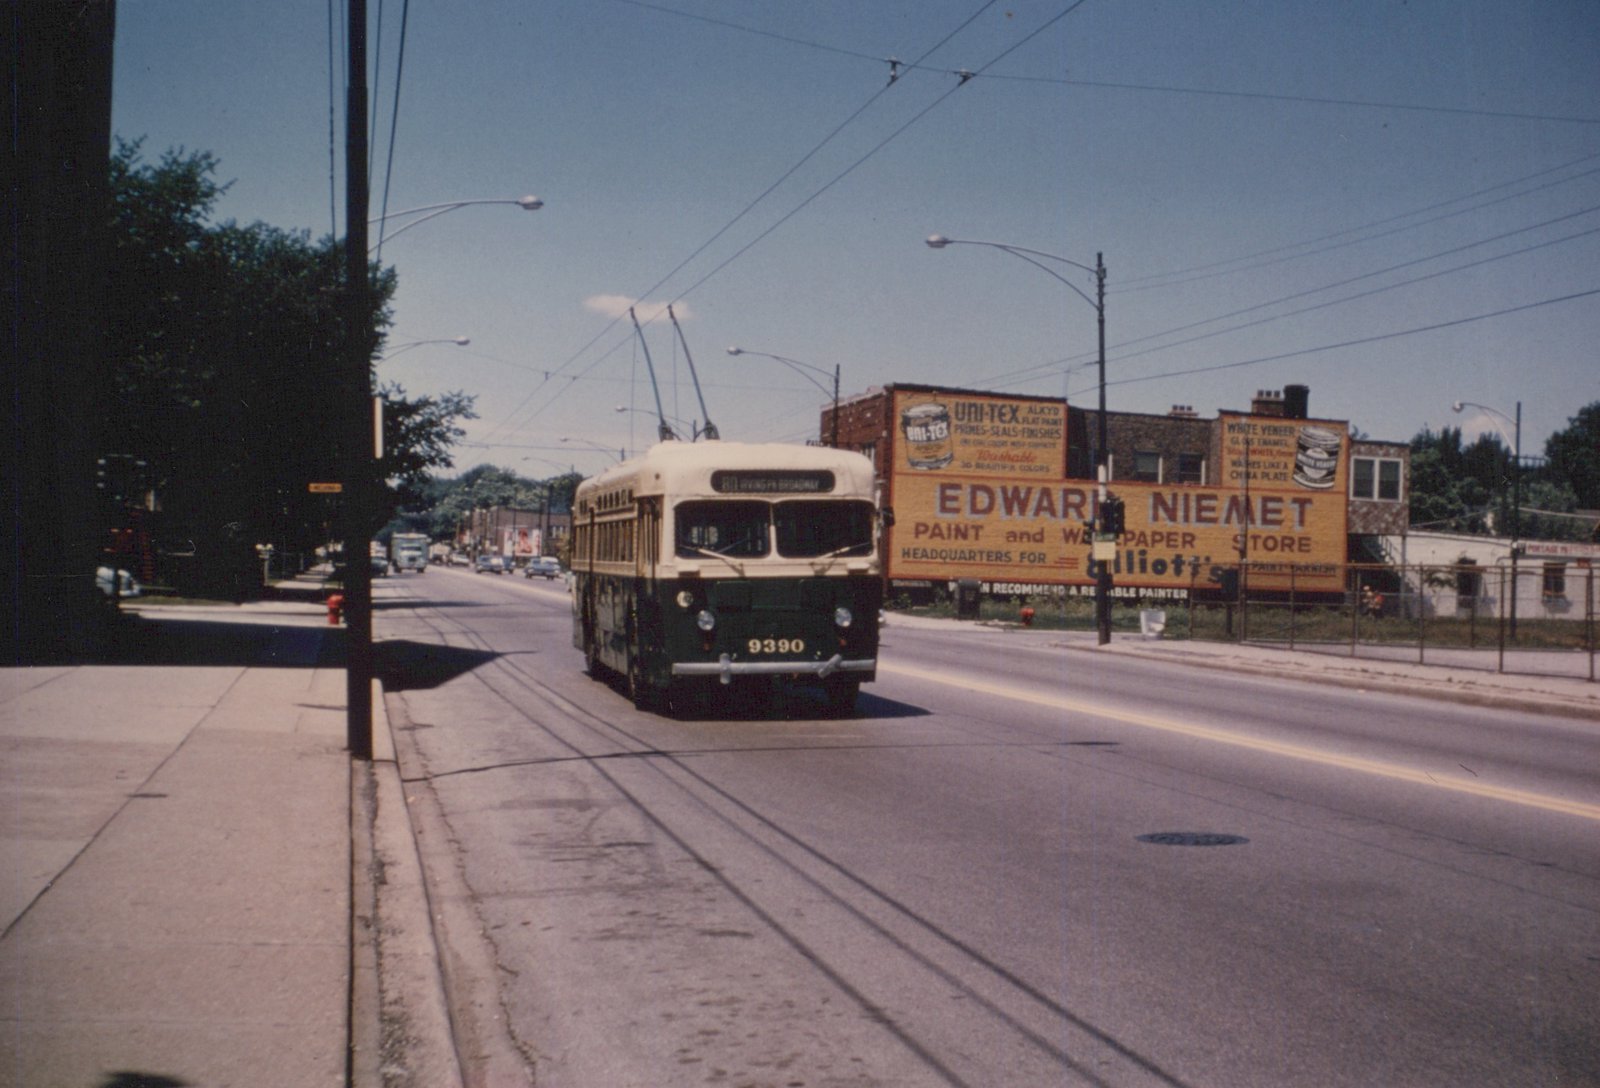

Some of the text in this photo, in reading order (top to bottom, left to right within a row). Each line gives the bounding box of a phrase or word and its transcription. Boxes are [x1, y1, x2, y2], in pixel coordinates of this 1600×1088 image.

[954, 402, 1019, 424] UNI-TEX
[1028, 404, 1060, 415] ALKYD
[1227, 423, 1258, 435] WHITE
[1231, 460, 1261, 469] WAHES
[1148, 492, 1313, 531] NIEMET
[914, 522, 1313, 553] PAINT and WAPAPER STORE
[902, 547, 1013, 562] HEADQUARTERS
[1019, 551, 1047, 563] FOR
[1069, 586, 1078, 595] A
[1080, 586, 1136, 598] REABLE
[1139, 588, 1188, 599] PAINTER
[748, 638, 805, 654] 9390
